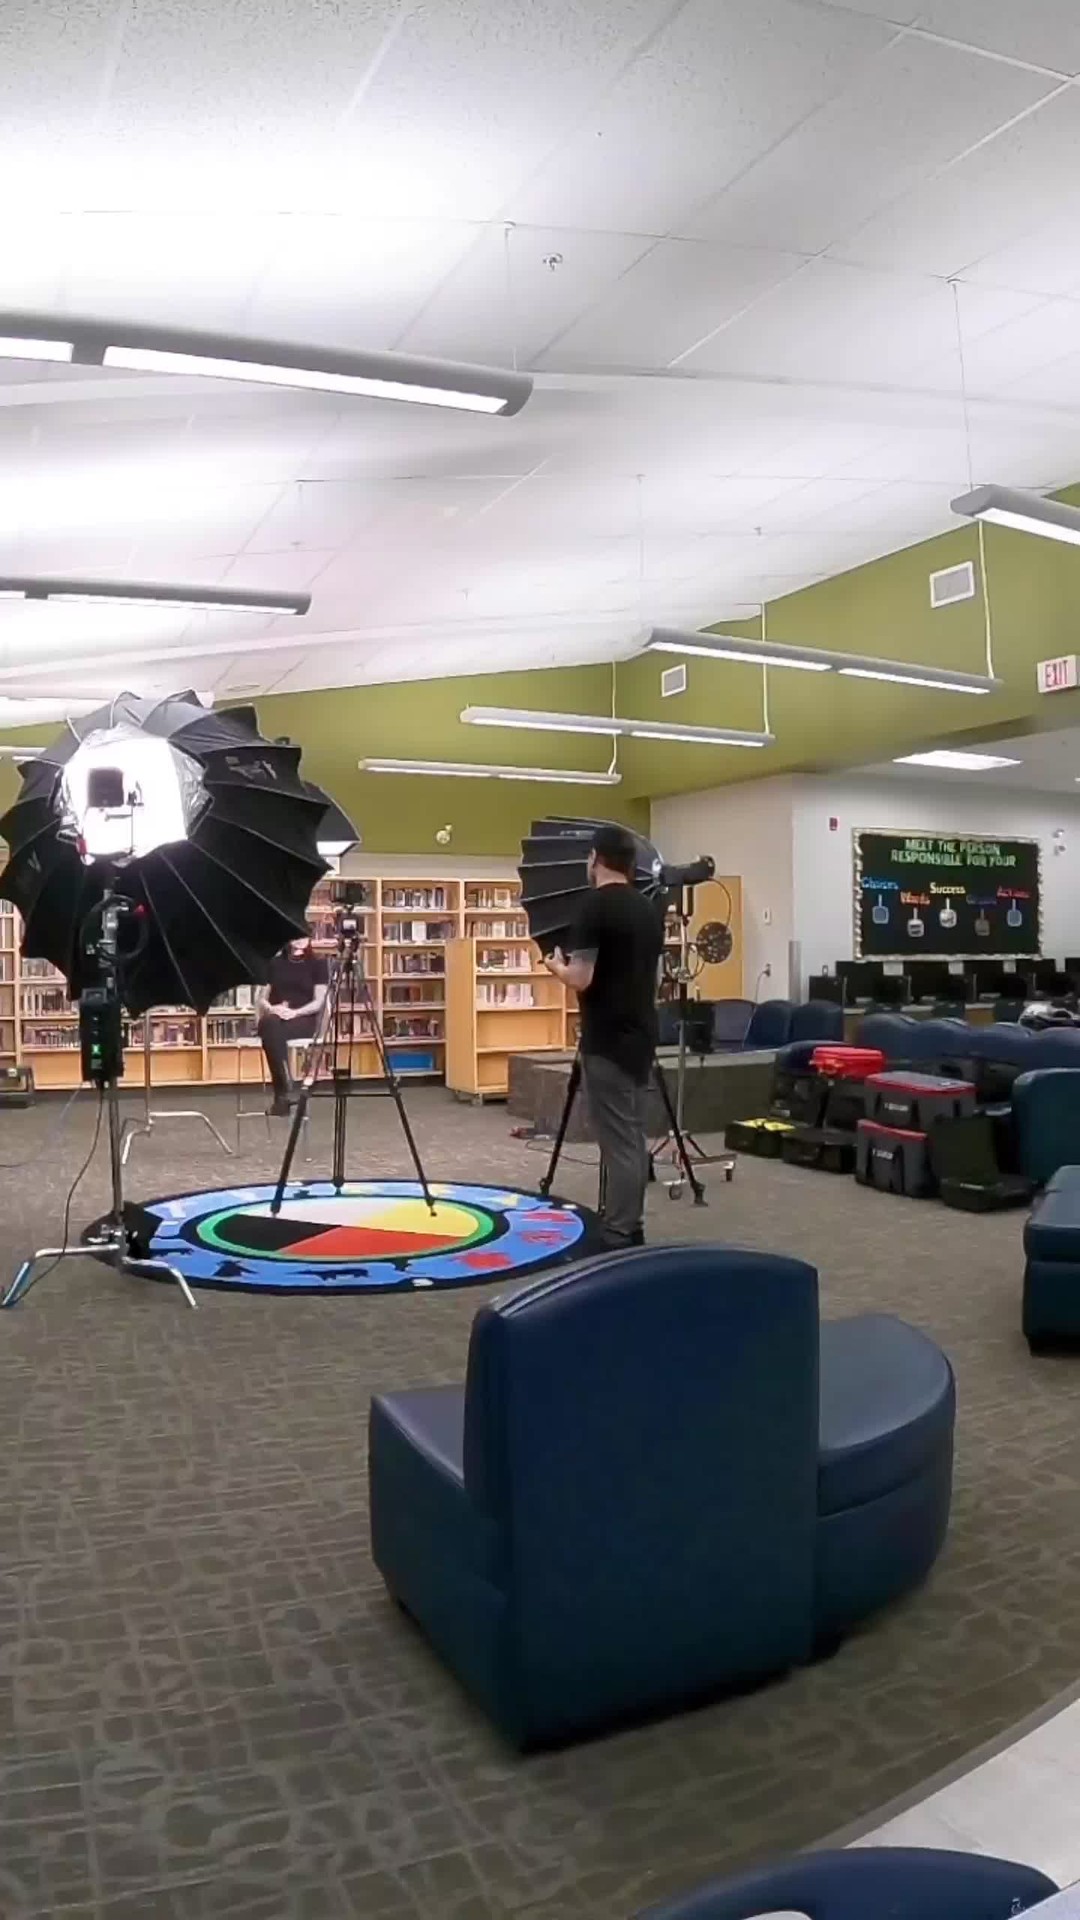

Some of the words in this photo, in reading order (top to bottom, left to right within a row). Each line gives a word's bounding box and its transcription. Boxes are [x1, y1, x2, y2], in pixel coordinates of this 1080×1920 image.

[1045, 660, 1068, 688] EXIT
[905, 839, 933, 851] MEET
[938, 840, 957, 853] THE
[960, 842, 1000, 855] PERSON
[891, 849, 963, 866] RESPONSIBLE
[967, 853, 987, 867] FOR
[988, 855, 1016, 868] YOUR
[929, 882, 966, 894] Success
